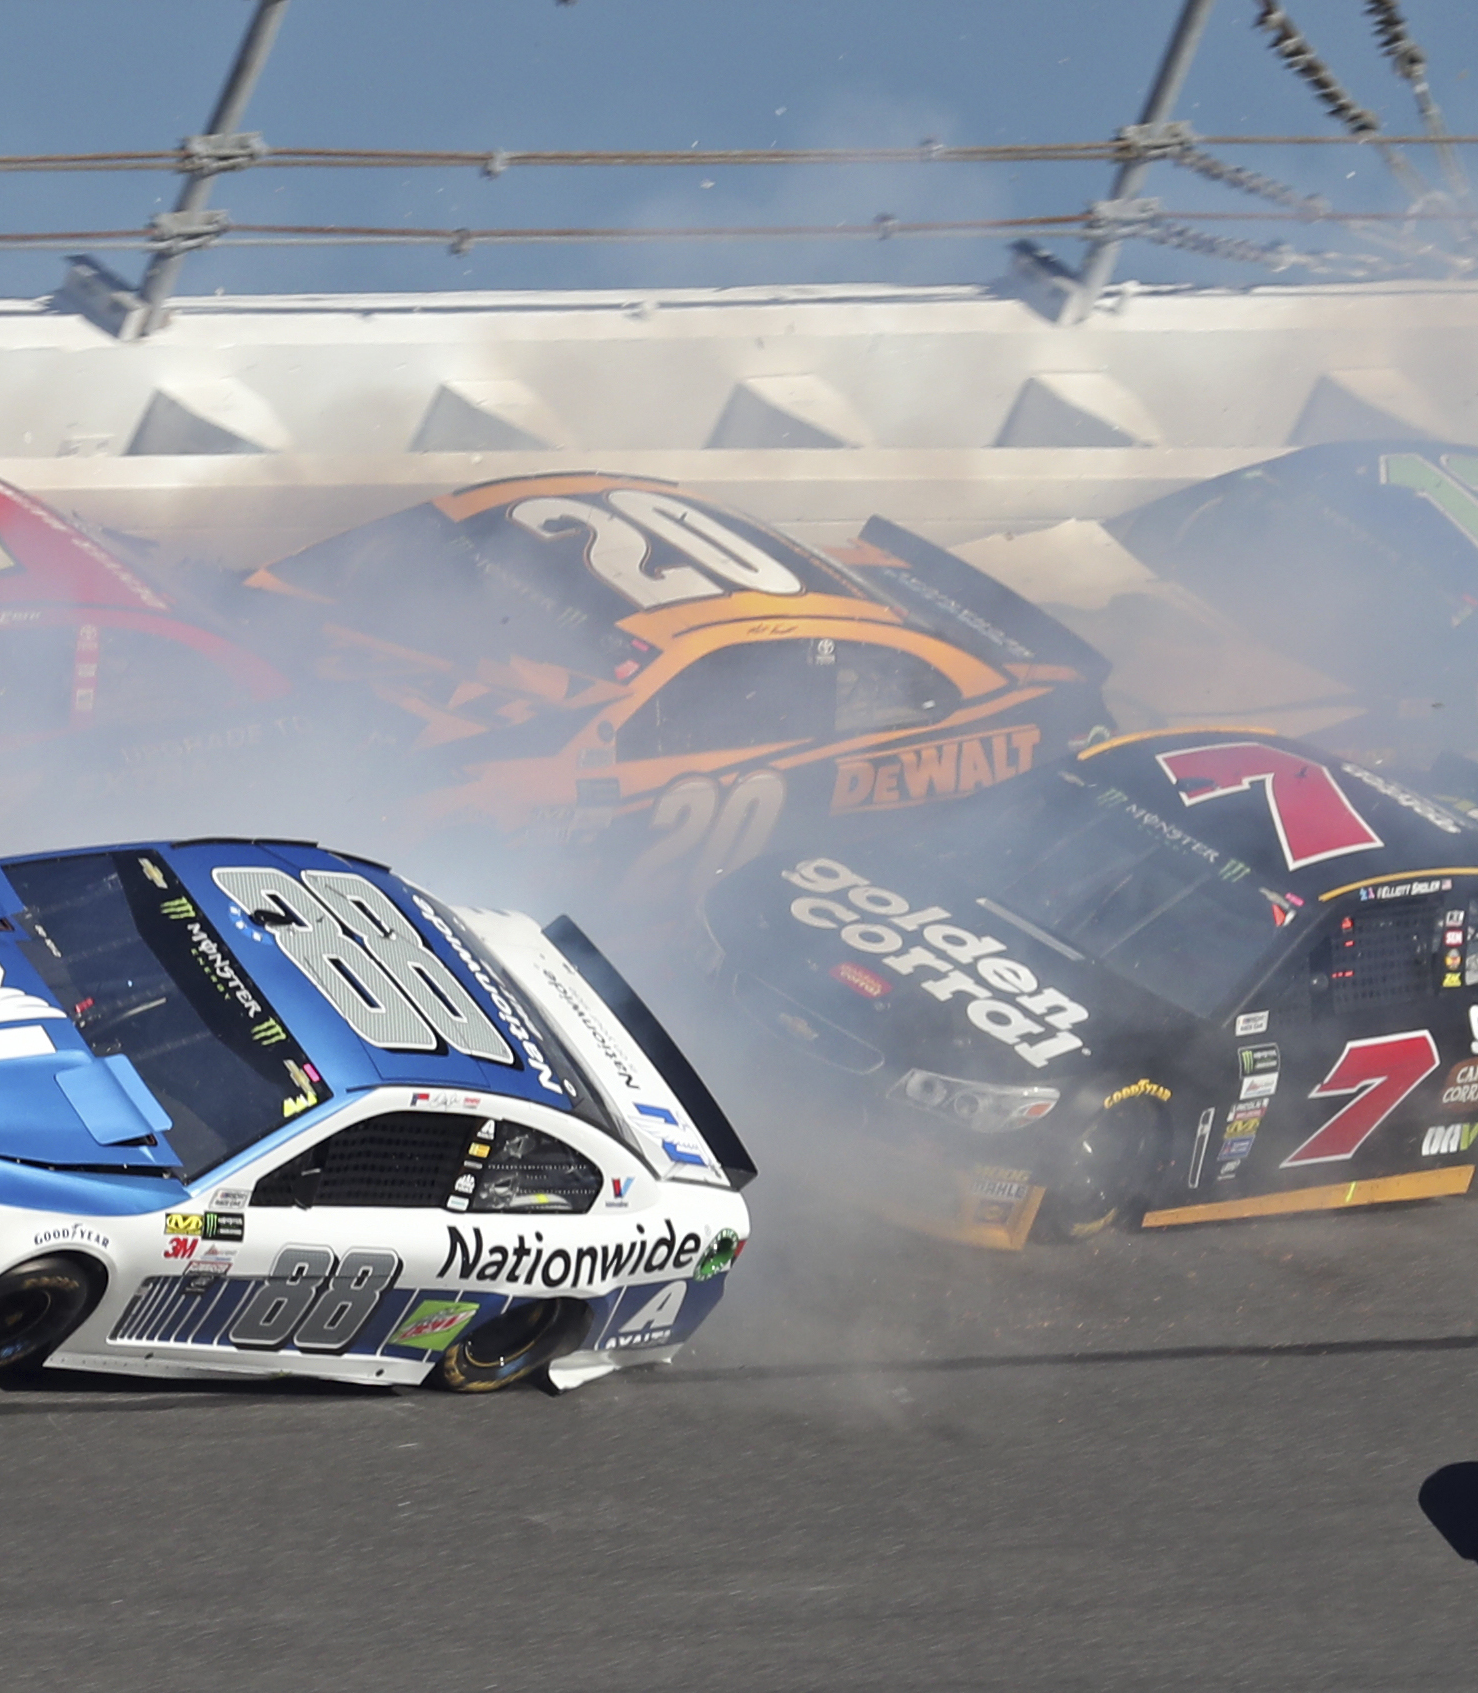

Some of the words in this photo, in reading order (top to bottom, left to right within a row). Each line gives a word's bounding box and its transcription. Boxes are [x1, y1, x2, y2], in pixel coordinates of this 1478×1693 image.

[509, 489, 804, 607] 20
[616, 772, 786, 895] 20
[1124, 803, 1220, 864] MONSTER
[1156, 742, 1385, 871] 7
[187, 922, 262, 1019] MONSTER
[211, 867, 515, 1066] 88
[781, 857, 1089, 1030] golden
[790, 896, 1084, 1068] corral
[1279, 1029, 1441, 1169] 7
[33, 1223, 110, 1249] GOODYEAR
[163, 1236, 200, 1259] 3M
[436, 1218, 702, 1290] Nationwide
[228, 1243, 404, 1350] 88
